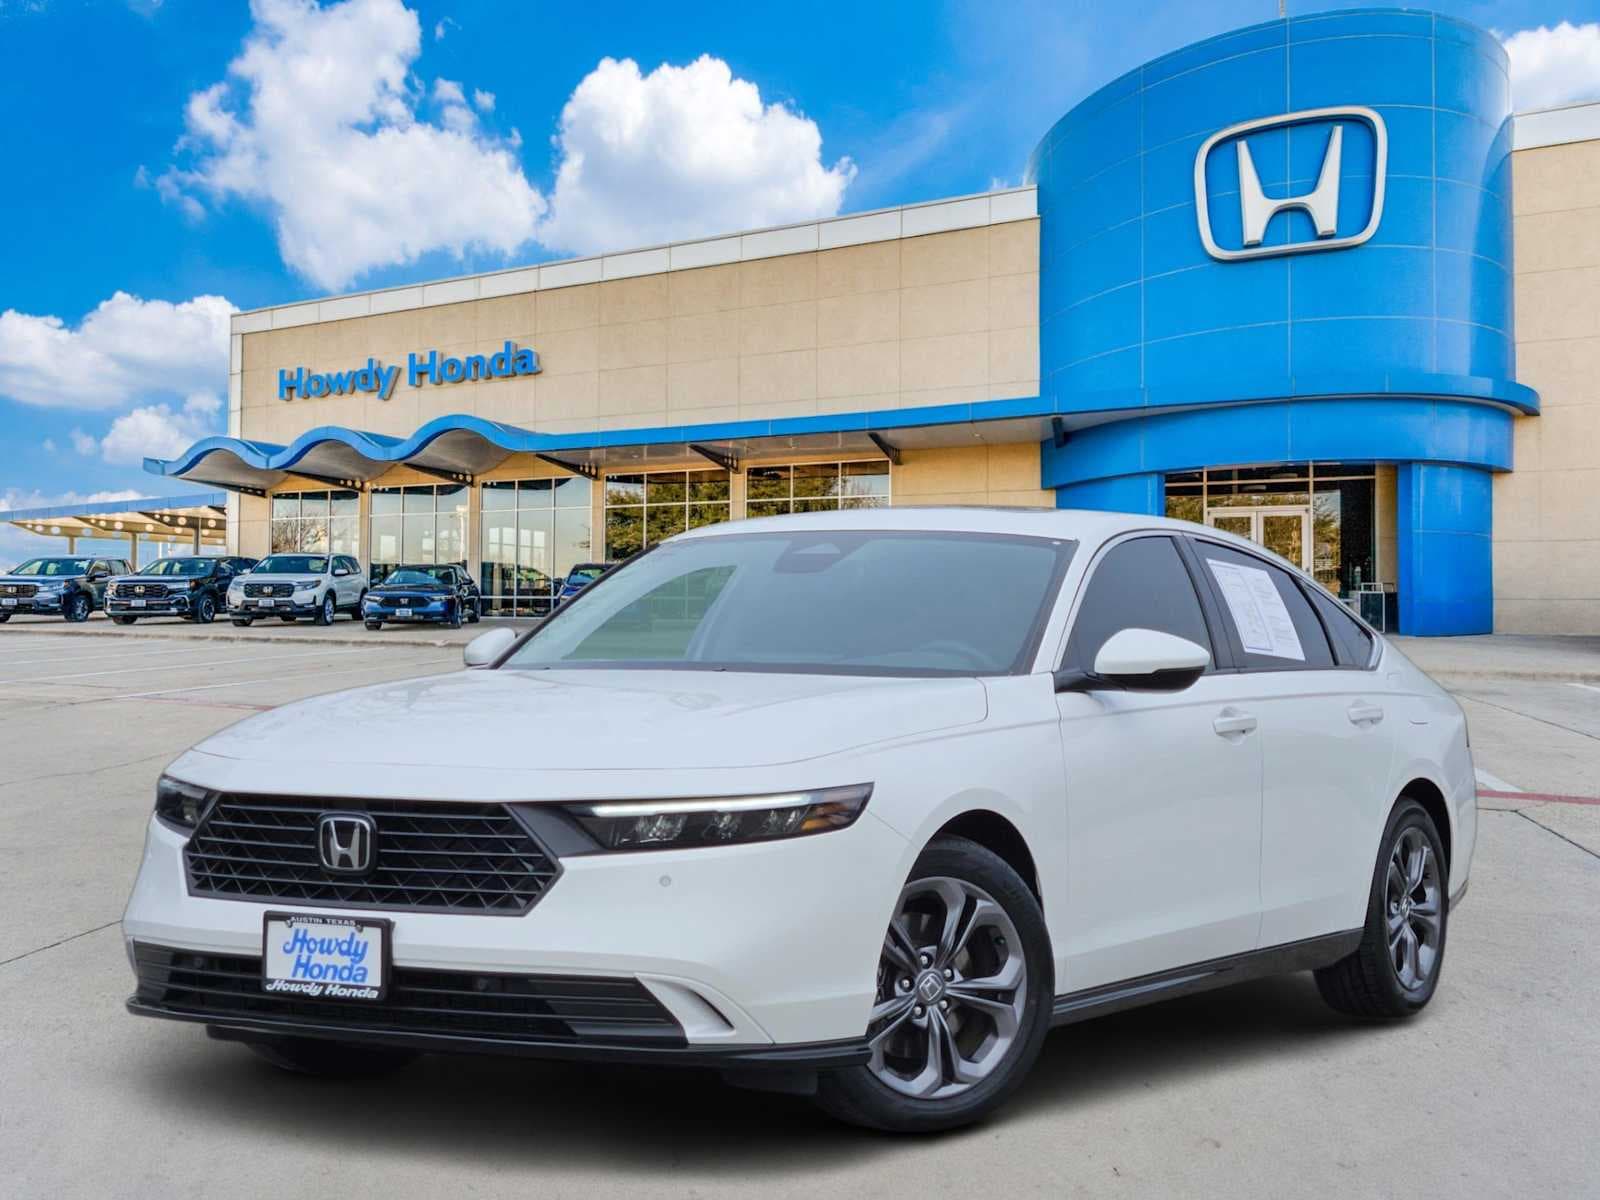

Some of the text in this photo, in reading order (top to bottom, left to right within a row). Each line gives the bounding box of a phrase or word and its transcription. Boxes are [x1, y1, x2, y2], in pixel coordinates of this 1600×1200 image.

[278, 341, 542, 400] Howdy Honda
[290, 916, 356, 927] AUSTIN TEXAS
[282, 928, 368, 963] Howdy
[292, 955, 368, 983] Honda
[265, 979, 379, 999] Howdy Honda
